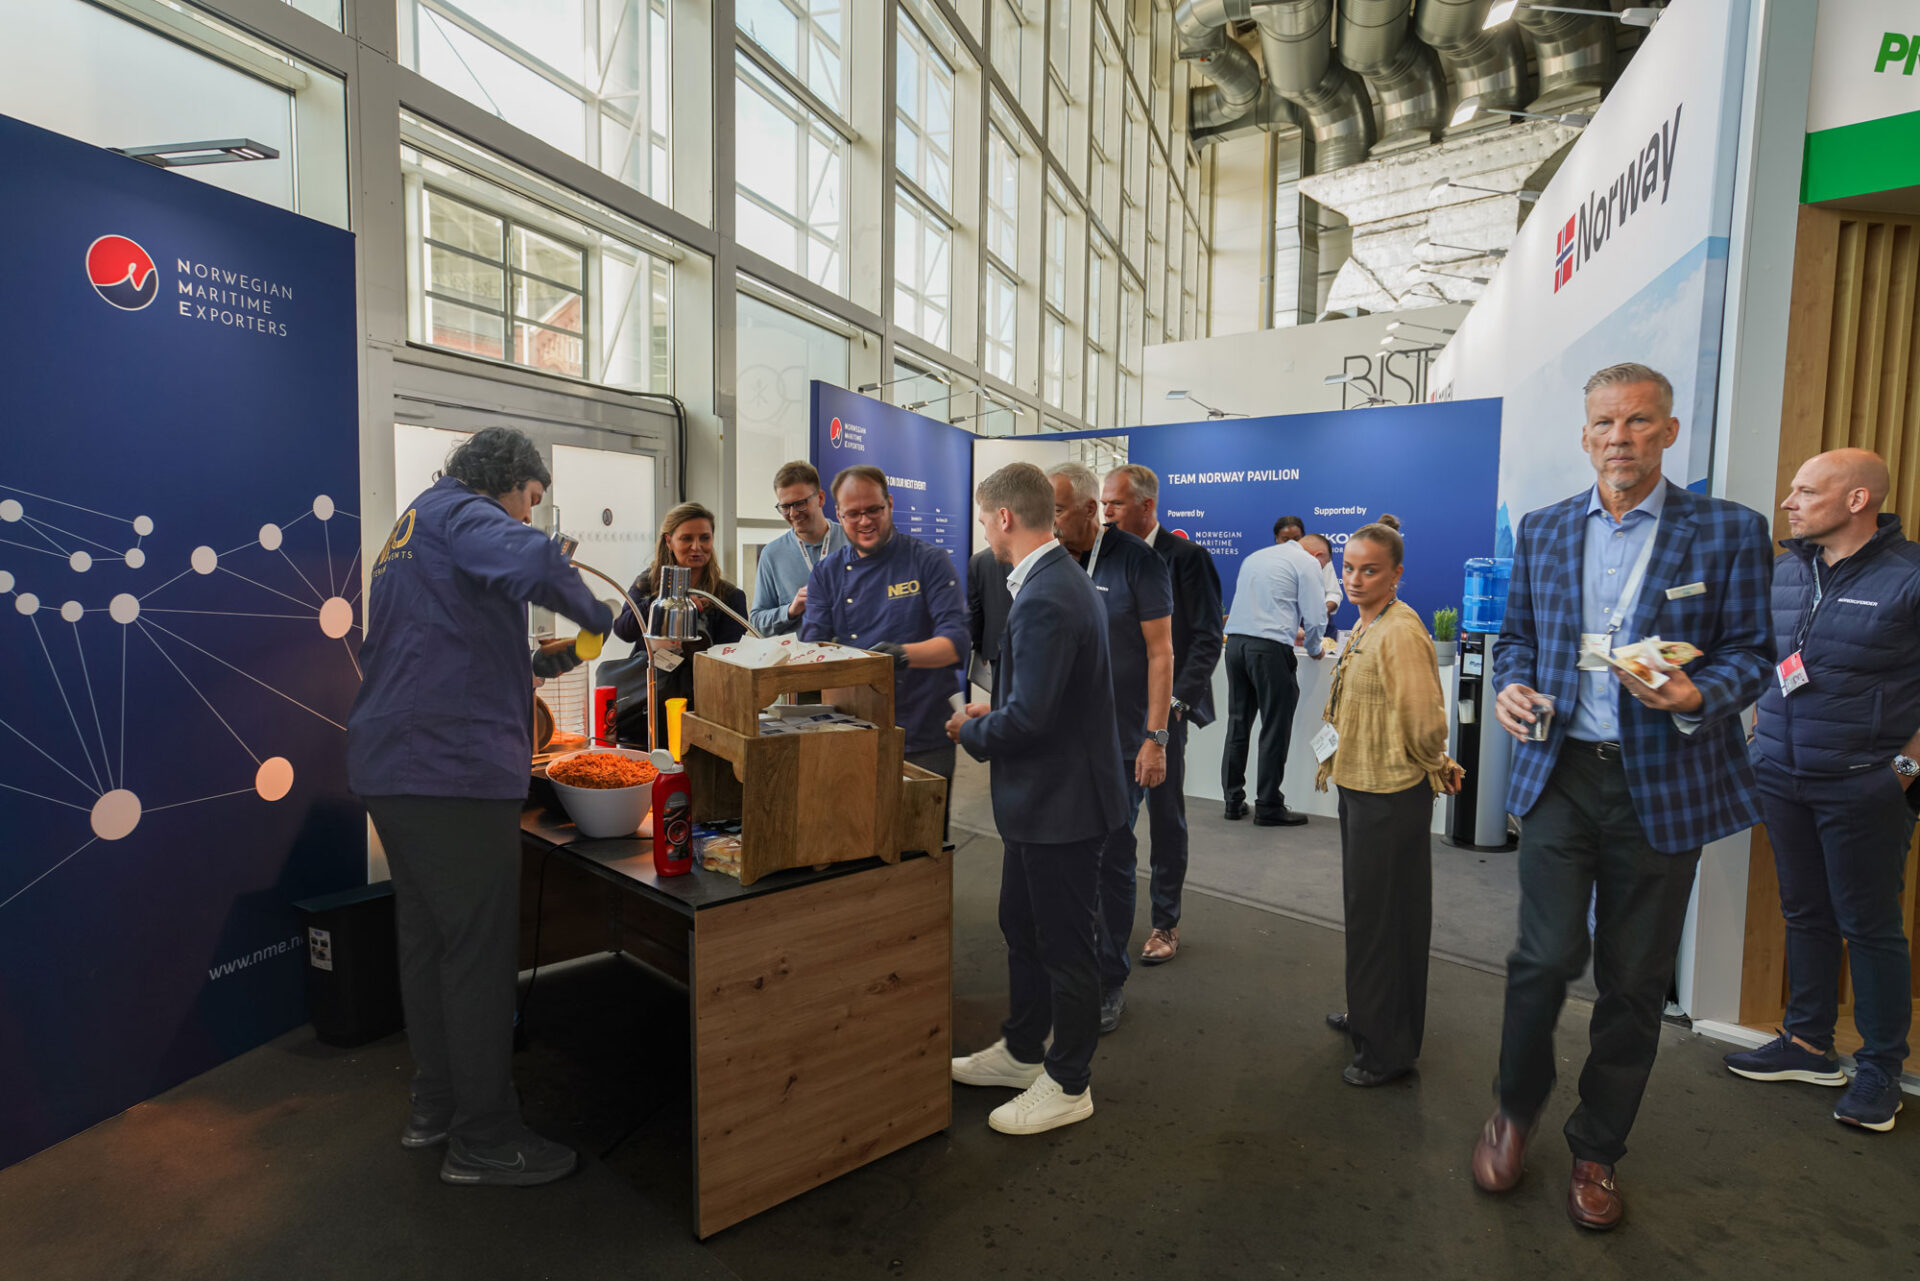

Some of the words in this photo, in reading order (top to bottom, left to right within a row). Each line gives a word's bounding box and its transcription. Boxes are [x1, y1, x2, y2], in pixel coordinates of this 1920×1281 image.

[1576, 102, 1683, 272] Norway
[177, 258, 293, 301] NORWEGIAN
[177, 279, 273, 315] MARITIME
[178, 302, 288, 338] EXPORTERS
[1168, 473, 1196, 485] TEAM
[1198, 470, 1245, 484] NORWAY
[1247, 468, 1300, 482] PAVILION
[1167, 509, 1196, 518] Powered
[1196, 509, 1205, 519] by
[1314, 505, 1356, 517] Supported
[1356, 505, 1367, 517] by
[1195, 531, 1242, 539] NORWEGIAN
[1195, 539, 1232, 547] MARITIME
[888, 579, 921, 597] NEO
